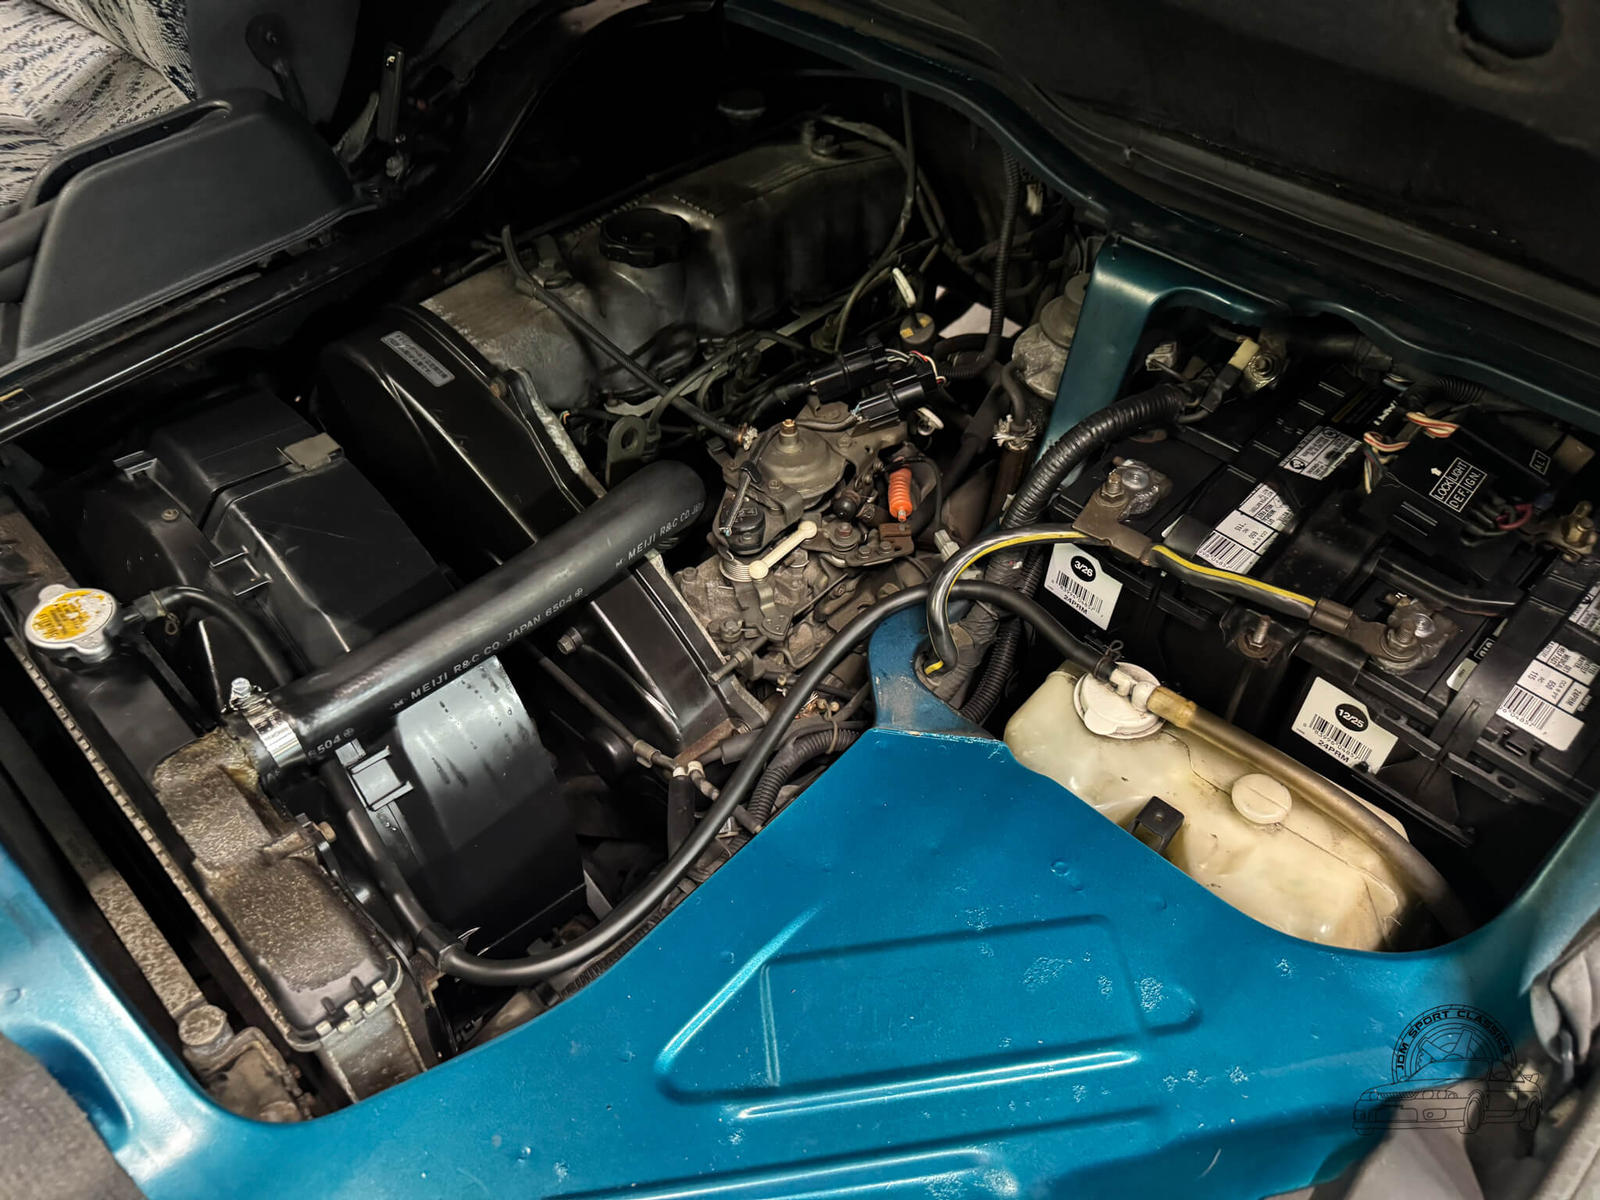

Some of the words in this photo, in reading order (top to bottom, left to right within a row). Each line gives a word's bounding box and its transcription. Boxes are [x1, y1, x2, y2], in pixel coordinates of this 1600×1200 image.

[1434, 480, 1455, 501] LOCK
[1450, 461, 1468, 481] LIGHT
[1449, 488, 1469, 508] DEF.
[1463, 471, 1482, 489] IGN.
[628, 533, 656, 560] MEIJI
[660, 518, 679, 537] R&C
[1074, 560, 1093, 577] 3/26
[410, 672, 448, 700] MEIJI
[453, 653, 480, 674] R&C
[506, 614, 541, 642] JAPAN
[1338, 709, 1364, 728] 12/25
[1317, 739, 1350, 763] 24PRM
